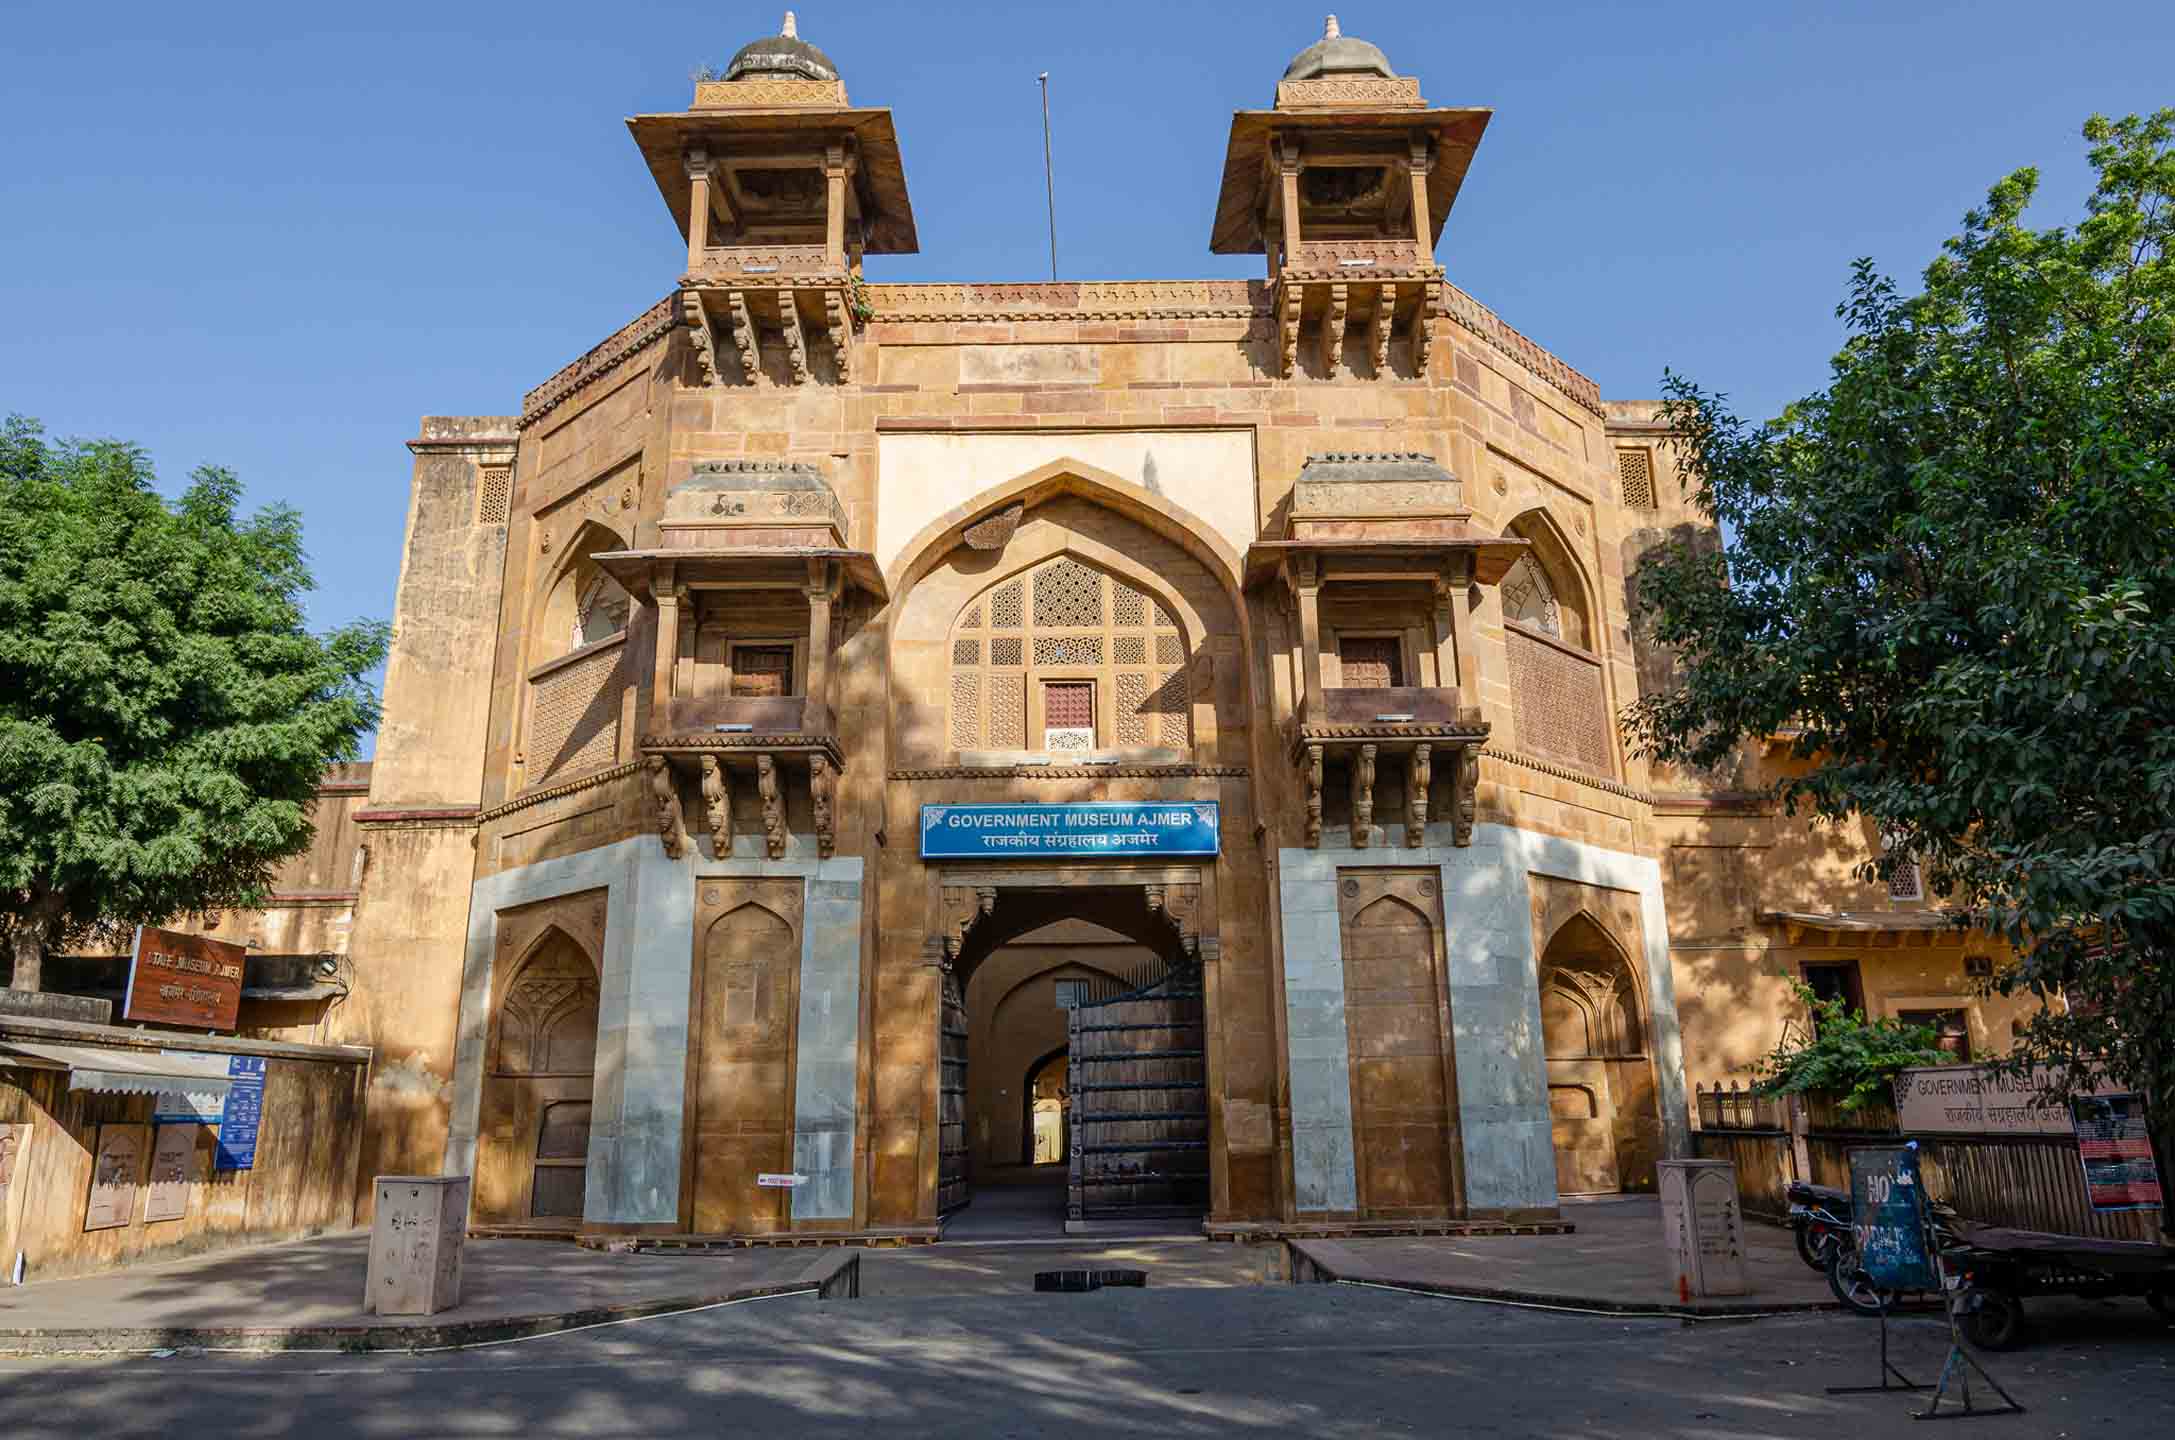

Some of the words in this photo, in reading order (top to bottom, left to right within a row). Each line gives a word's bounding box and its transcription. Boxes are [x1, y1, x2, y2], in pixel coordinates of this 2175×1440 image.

[949, 813, 1060, 828] GOVERNMENT
[1065, 813, 1133, 827] MUSEUM
[1137, 812, 1192, 826] AJMER
[981, 831, 1041, 848] राजकीय
[1044, 831, 1107, 849] संग्रहालय
[1111, 829, 1159, 847] अजमेर
[1918, 1077, 1993, 1097] GOVERNMENT
[1998, 1073, 2050, 1094] MUSEUM
